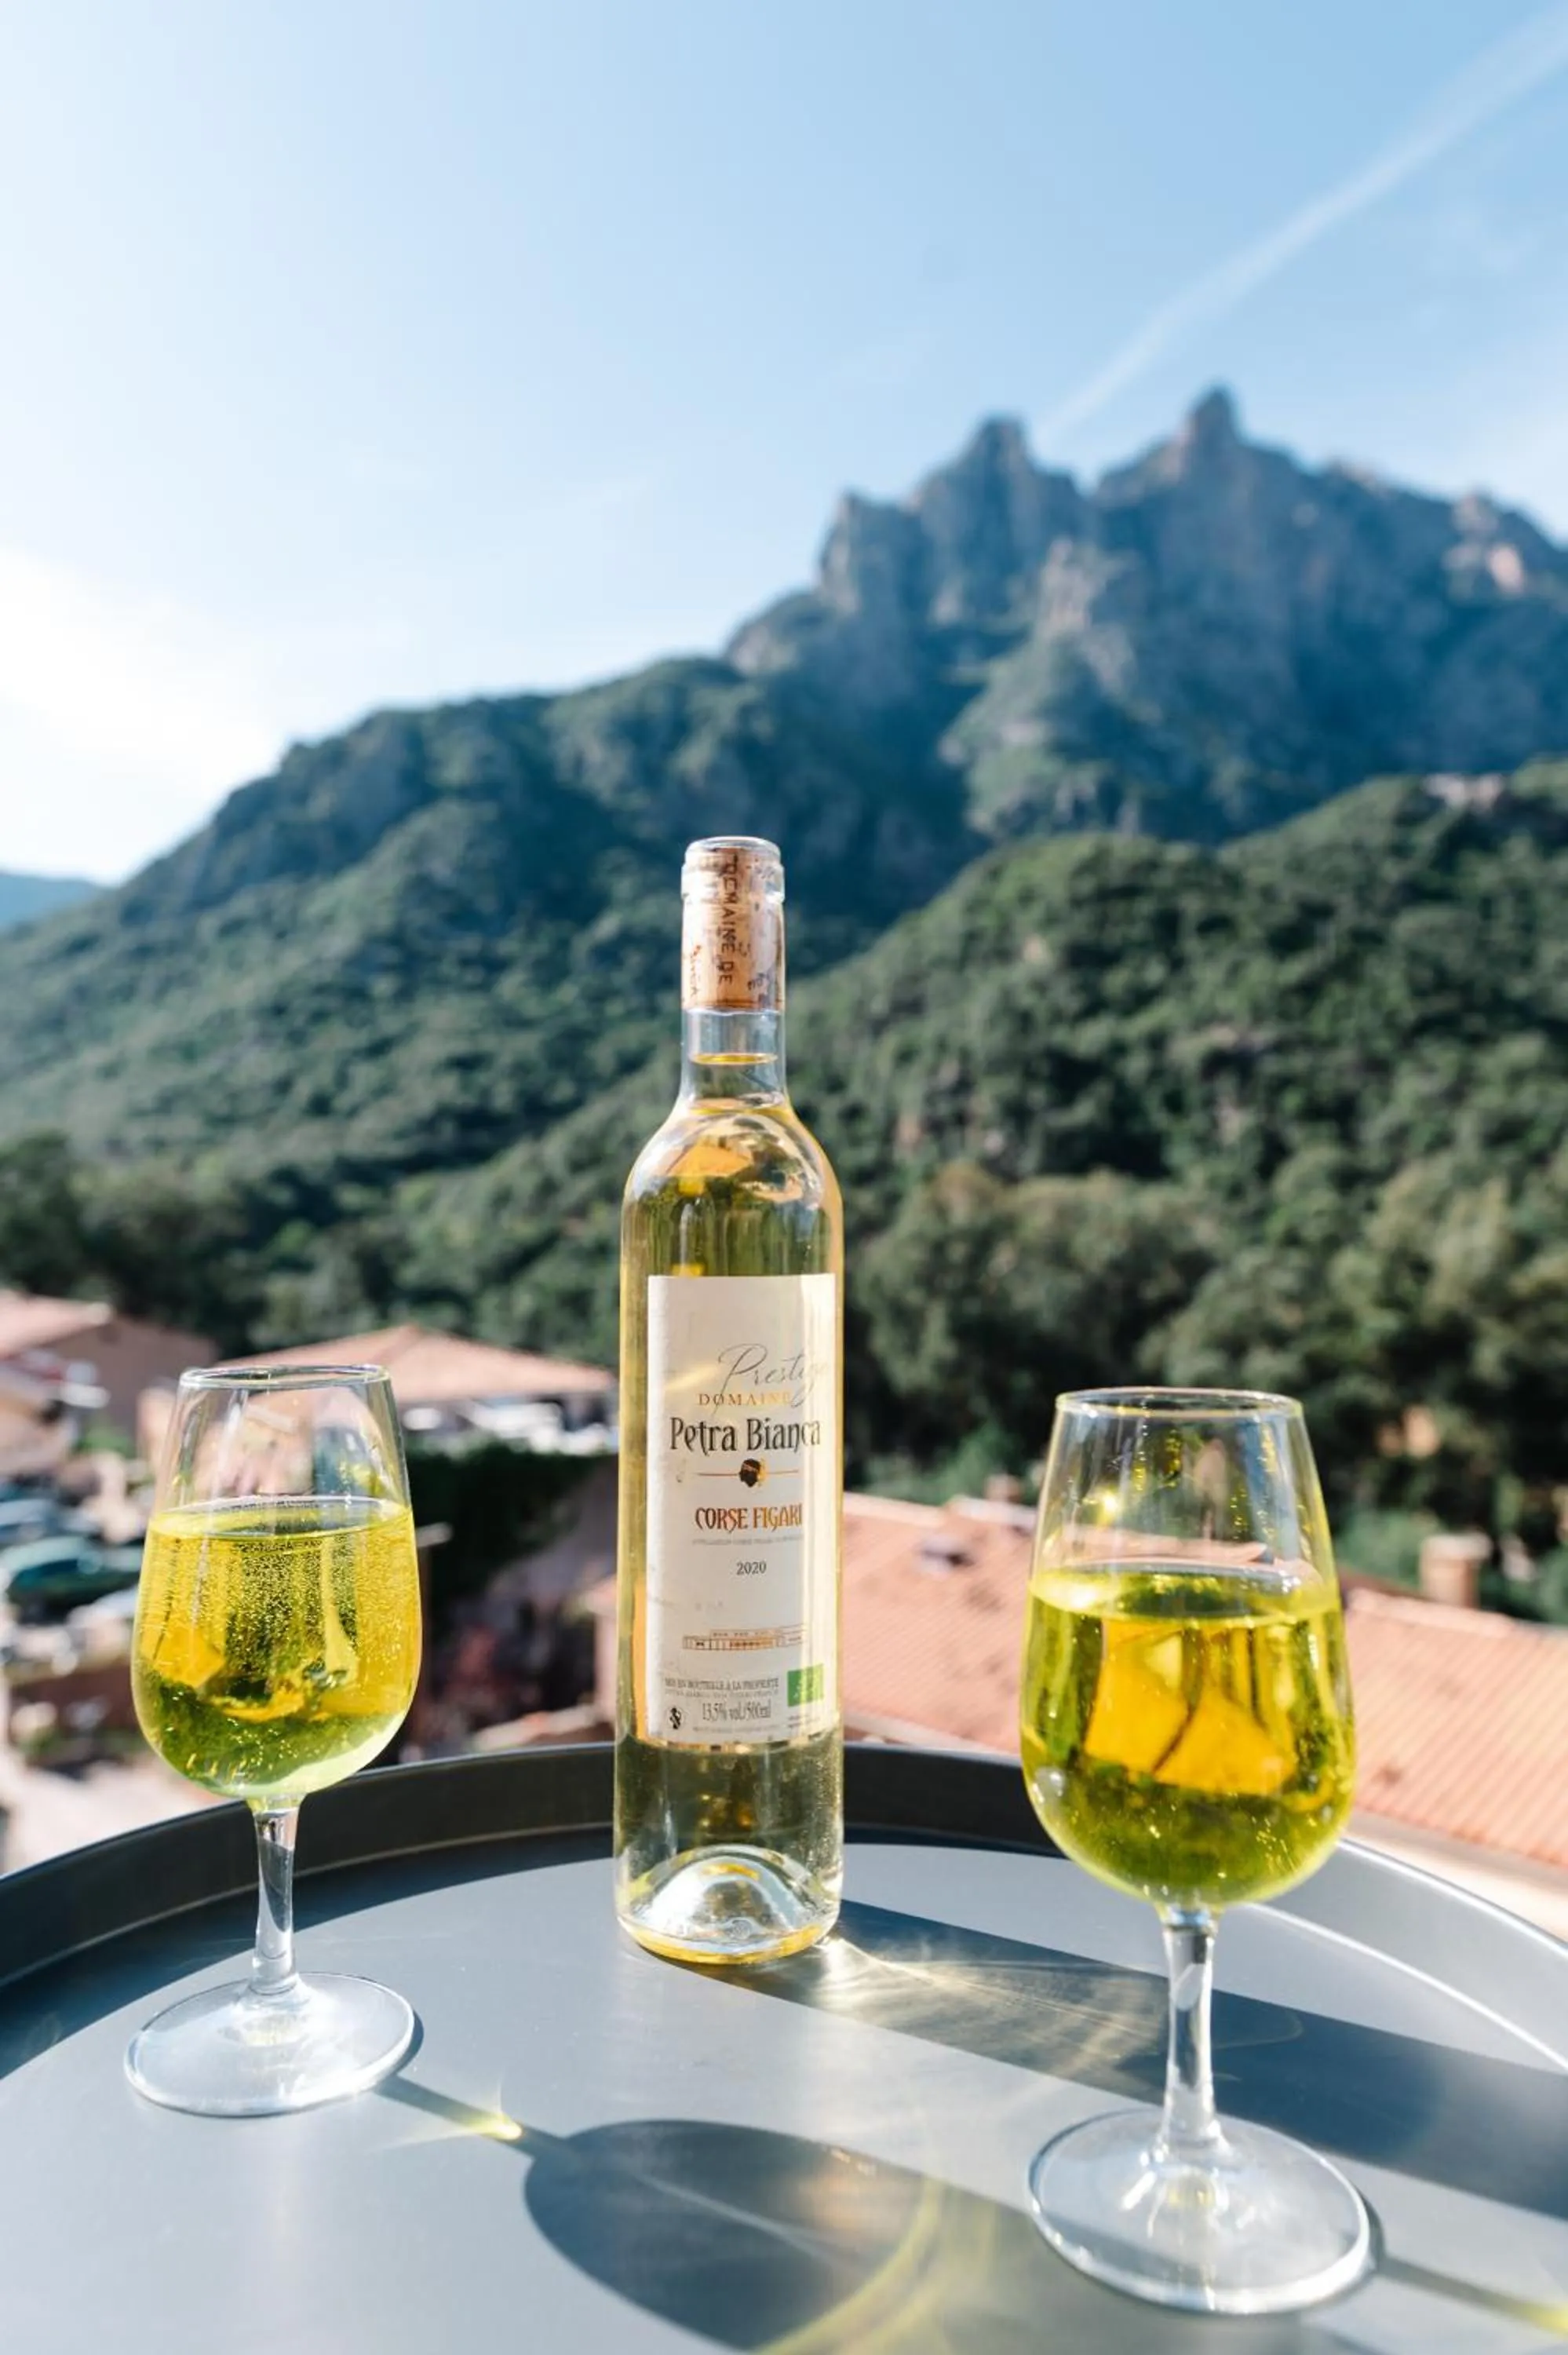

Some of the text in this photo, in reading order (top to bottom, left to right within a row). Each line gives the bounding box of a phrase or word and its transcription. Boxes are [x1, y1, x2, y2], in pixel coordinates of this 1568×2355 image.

[697, 1392, 792, 1406] DOMAINE
[669, 1416, 821, 1457] Petra Bianca
[695, 1502, 803, 1534] CORSE FIGARI
[736, 1561, 767, 1575] 2020
